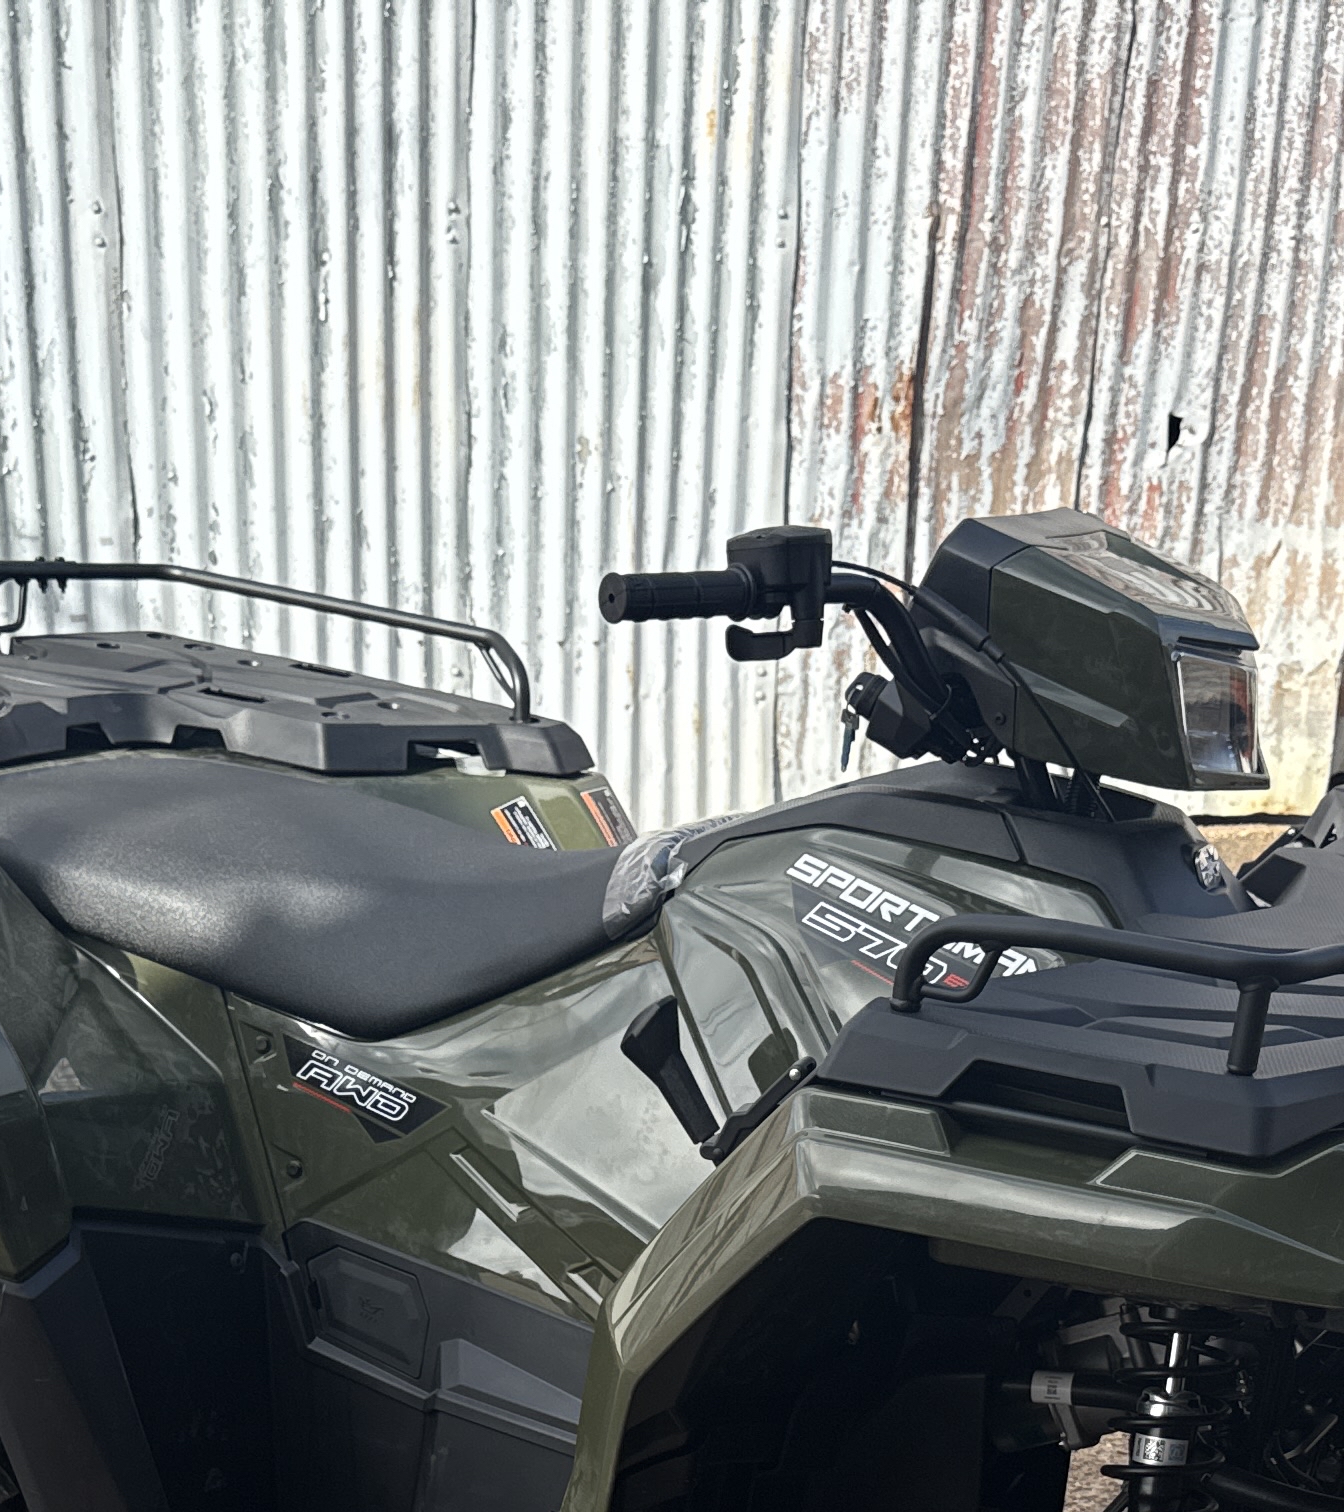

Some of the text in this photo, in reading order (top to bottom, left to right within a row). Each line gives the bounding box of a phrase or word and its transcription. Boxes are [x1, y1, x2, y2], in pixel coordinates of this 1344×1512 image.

[295, 1060, 409, 1122] AWD
[311, 1049, 416, 1103] ON DEMAND
